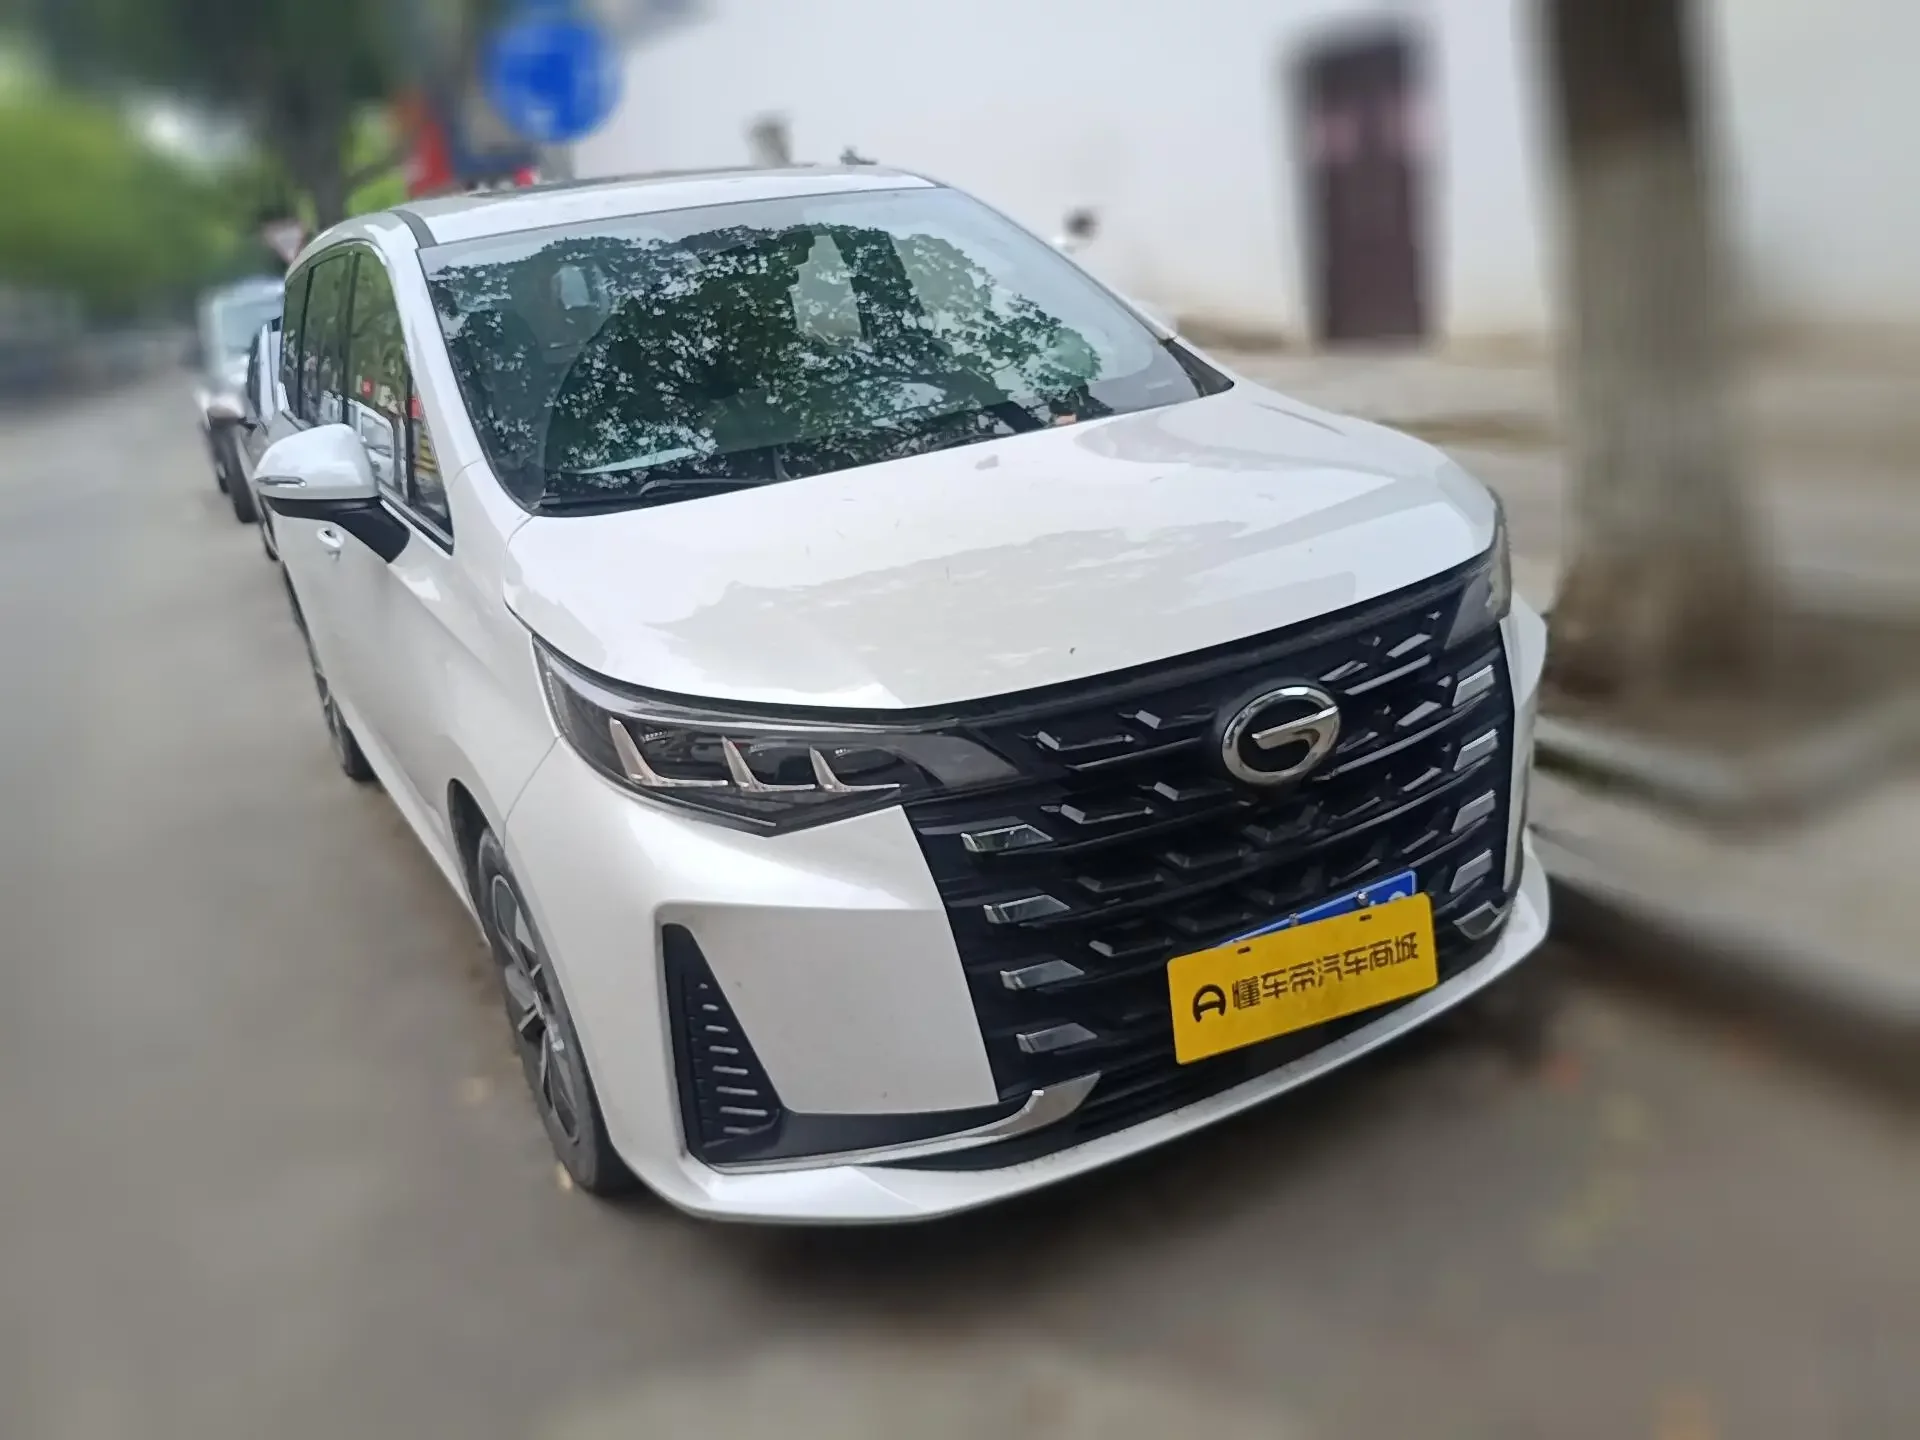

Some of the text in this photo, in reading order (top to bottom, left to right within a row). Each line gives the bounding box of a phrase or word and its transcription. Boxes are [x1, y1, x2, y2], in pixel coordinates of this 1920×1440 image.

[1232, 931, 1419, 1010] 懂车帝汽车商城
